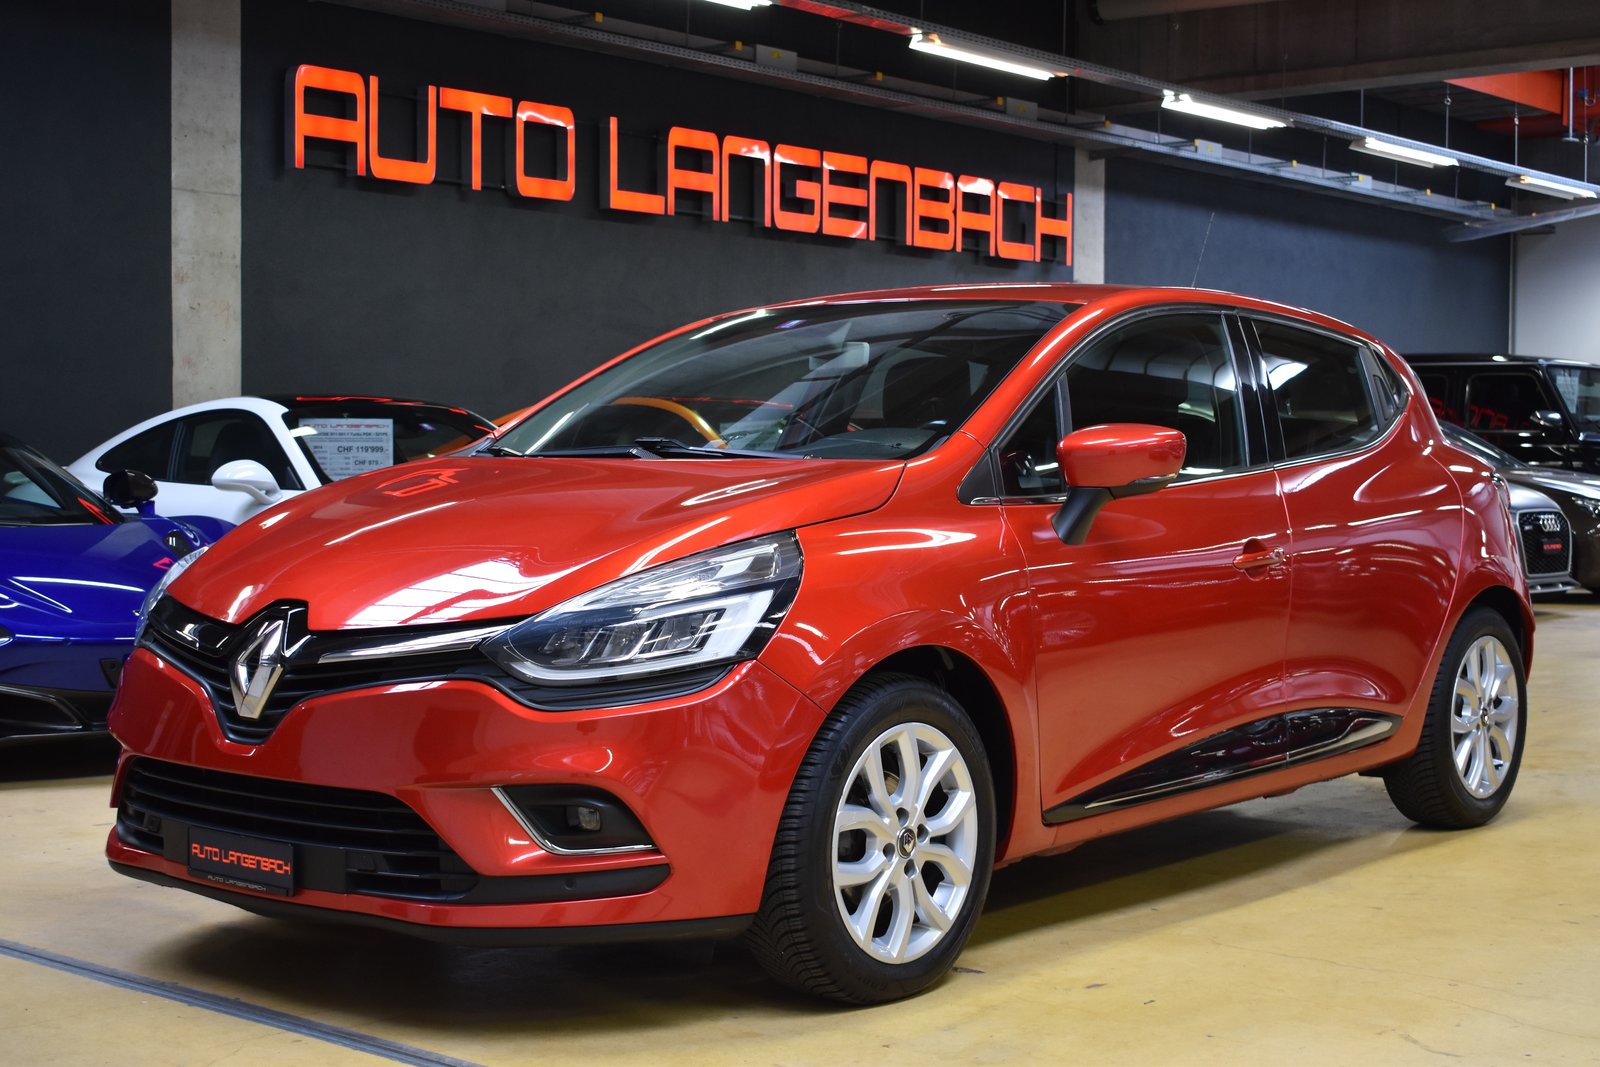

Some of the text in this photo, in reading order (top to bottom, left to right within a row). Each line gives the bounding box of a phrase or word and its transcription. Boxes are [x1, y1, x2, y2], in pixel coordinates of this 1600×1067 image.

[294, 63, 1073, 267] AUTO LANGENBACH
[337, 445, 353, 453] CHF
[191, 842, 291, 875] AUTO LANGENBACH
[207, 874, 267, 891] AUTO LANGENBACH
